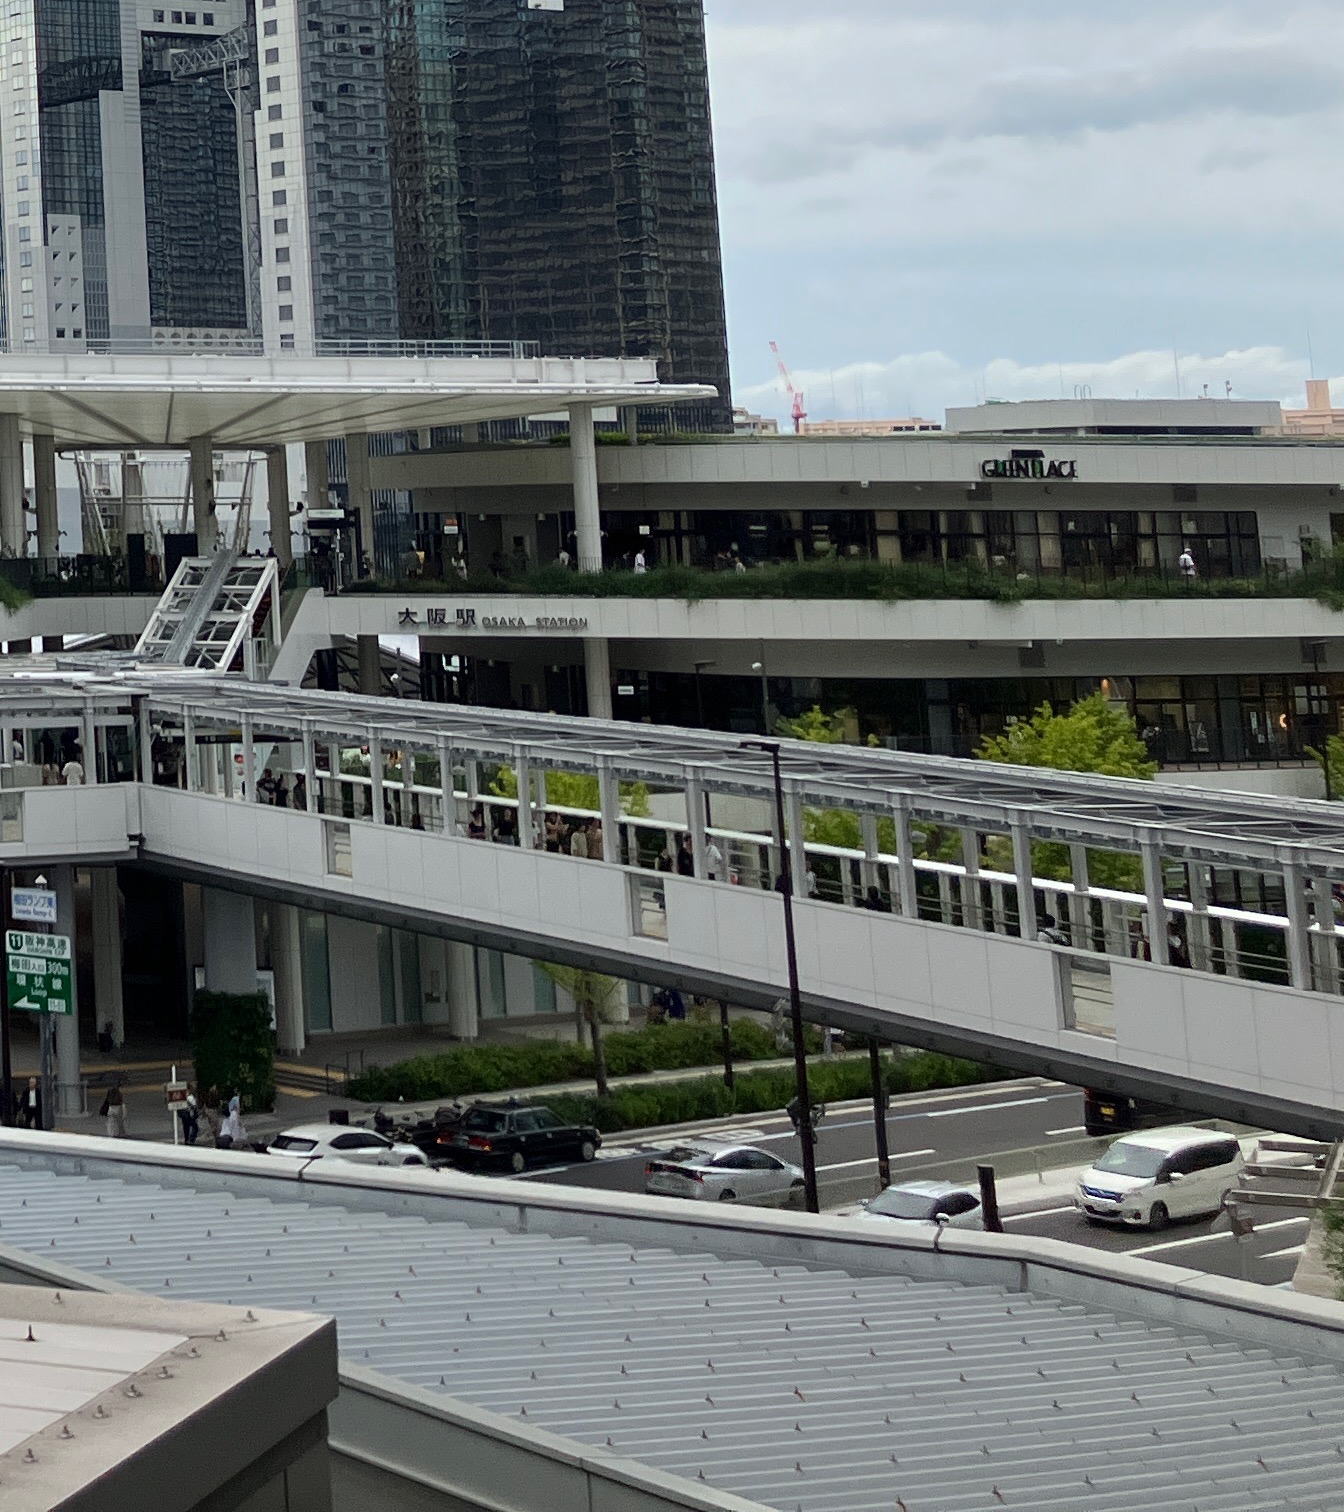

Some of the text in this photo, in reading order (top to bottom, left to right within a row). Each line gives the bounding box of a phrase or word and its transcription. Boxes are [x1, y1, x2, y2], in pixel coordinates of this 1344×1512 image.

[398, 607, 588, 629] 大阪駅 OSAKA STATION
[25, 934, 67, 949] 阪神高速
